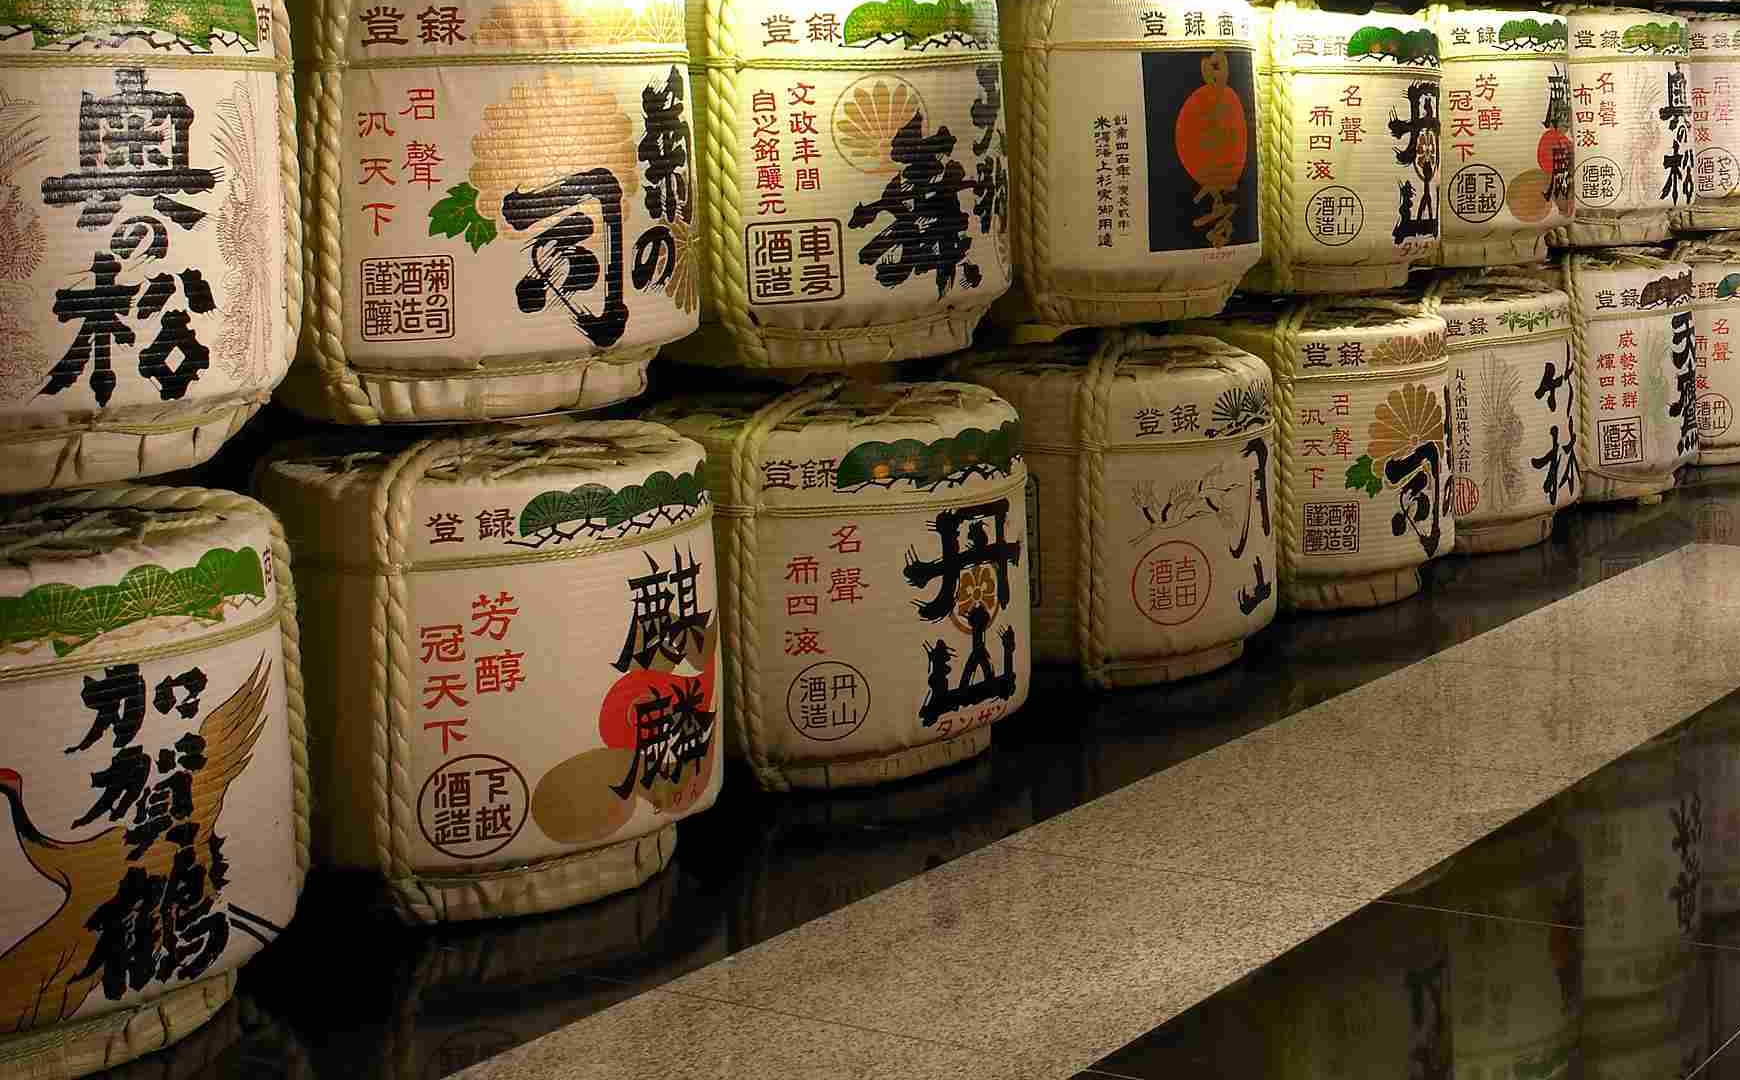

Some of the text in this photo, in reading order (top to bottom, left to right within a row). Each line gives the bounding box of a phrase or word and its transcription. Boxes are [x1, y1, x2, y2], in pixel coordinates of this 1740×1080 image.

[360, 5, 466, 48] 登録
[762, 12, 841, 47] 登録
[1451, 25, 1497, 45] 登録
[1574, 29, 1621, 50] 登録
[1475, 73, 1504, 132] 芳醇
[1449, 90, 1475, 163] 冠天下
[1457, 173, 1477, 214] 酒造
[1478, 172, 1497, 213] 下越
[1314, 196, 1336, 237] 酒造
[1336, 196, 1355, 237] 丹山
[1595, 289, 1641, 311] 登録
[1302, 342, 1364, 368] 登録
[1133, 404, 1200, 437] 登録
[761, 459, 838, 491] 登録
[425, 509, 516, 545] 登録
[903, 498, 1021, 727] 丹山
[471, 592, 526, 696] 芳醇
[418, 624, 470, 755] 冠天下
[609, 544, 717, 798] 麒麟
[800, 676, 827, 730] 酒造
[831, 673, 858, 727] 丹山
[433, 771, 472, 846] 酒造
[474, 768, 512, 840] 下越
[64, 663, 231, 1001] 加賀鶴
